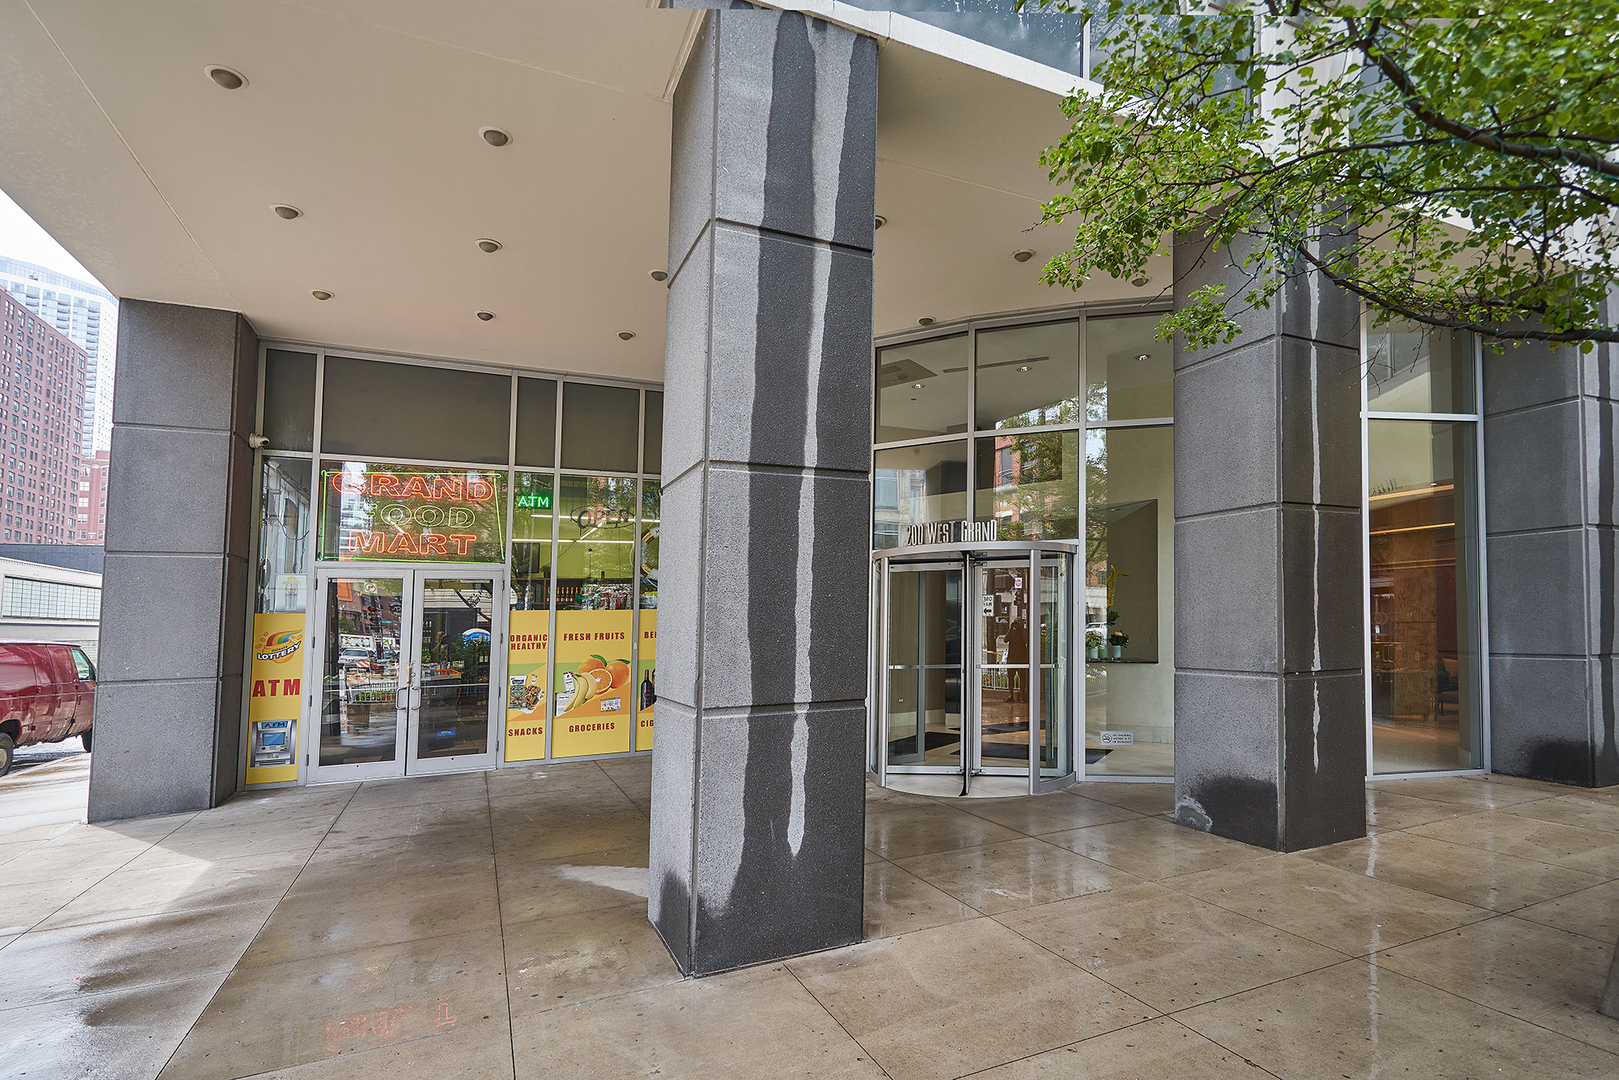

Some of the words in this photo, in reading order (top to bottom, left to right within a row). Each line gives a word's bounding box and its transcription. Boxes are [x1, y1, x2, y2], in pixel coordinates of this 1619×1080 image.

[332, 472, 494, 502] GRAND
[517, 496, 549, 508] ATM
[906, 524, 924, 546] 200
[927, 521, 956, 544] WEST
[961, 519, 998, 542] GRAND
[350, 530, 478, 556] MART
[509, 634, 548, 643] ORGANIC
[563, 633, 591, 642] FRESH
[594, 632, 626, 641] FRUITS
[257, 640, 302, 661] LOTTERY
[510, 642, 547, 651] HEALTHY
[252, 678, 301, 697] ATM
[508, 727, 543, 737] SNACKS
[568, 722, 615, 733] GROCERIES
